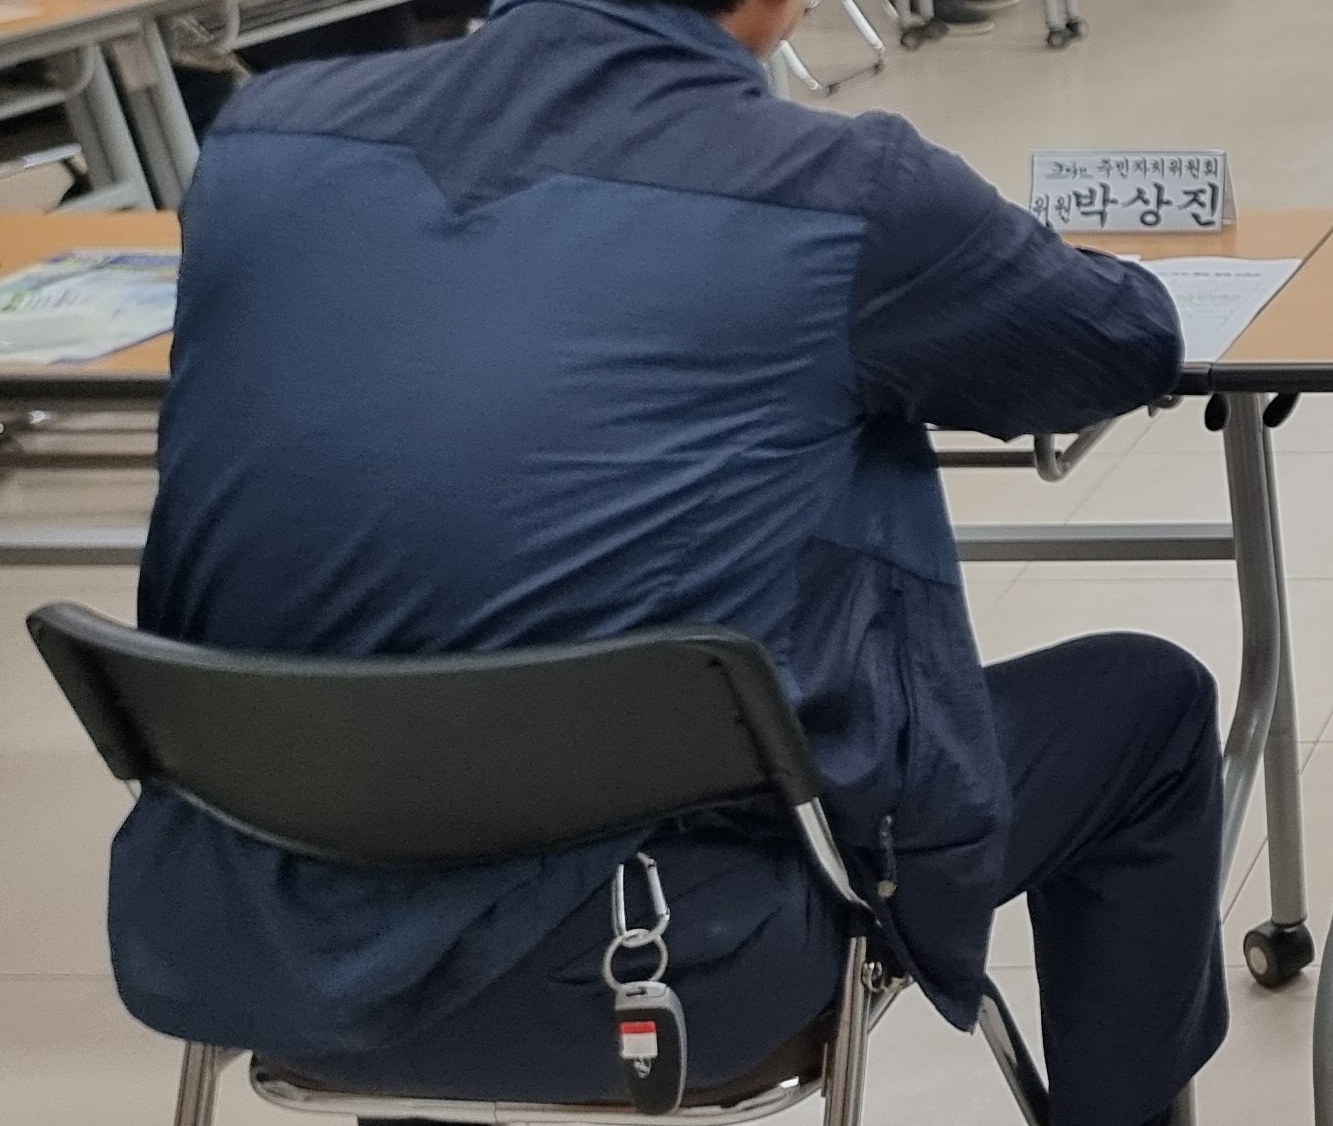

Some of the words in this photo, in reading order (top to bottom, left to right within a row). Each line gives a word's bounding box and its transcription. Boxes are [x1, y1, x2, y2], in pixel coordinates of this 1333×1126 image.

[1098, 157, 1219, 179] 주민자치위원회
[1034, 192, 1073, 226] 위원
[1072, 181, 1220, 228] 박상진
